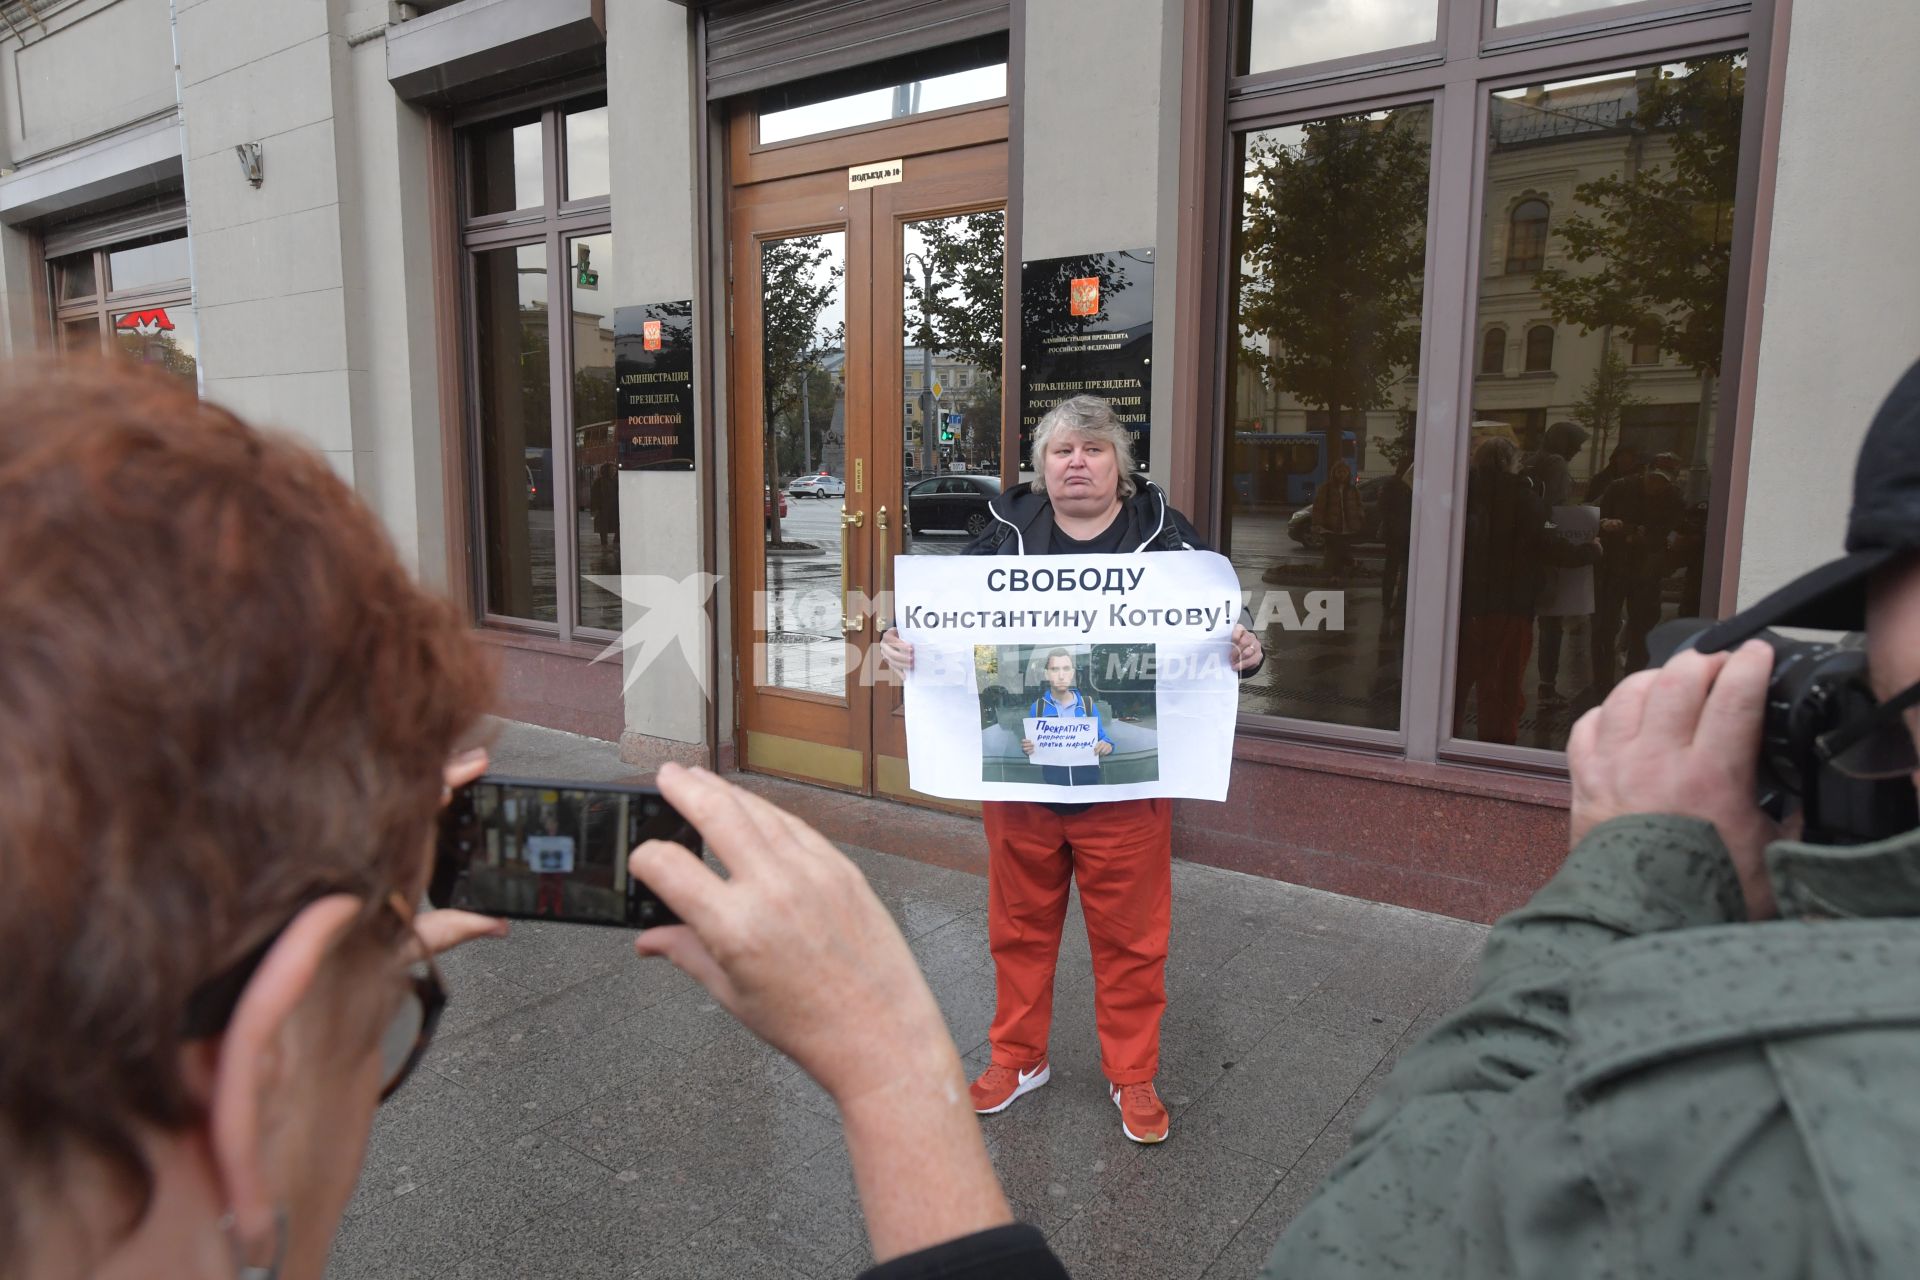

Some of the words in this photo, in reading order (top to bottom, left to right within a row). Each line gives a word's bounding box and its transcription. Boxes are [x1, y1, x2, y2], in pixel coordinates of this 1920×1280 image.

[852, 171, 883, 182] ПОДЪЕЗД
[1043, 335, 1090, 344] АДМИНИСТРАЦИЯ
[1092, 333, 1128, 341] ПРЕЗИДЕНТА
[1049, 345, 1086, 353] РОССИЙСКОЙ
[621, 372, 689, 384] АДМИНИСТРАЦИЯ
[1029, 382, 1083, 391] УПРАВЛЕНИЕ
[1085, 379, 1141, 389] ПРЕЗИДЕНТА
[630, 394, 679, 404] ПРЕЗИДЕНТА
[1029, 398, 1064, 408] РОССИЙ
[629, 413, 682, 424] РОССИЙСКОЙ
[632, 436, 679, 446] ФЕДЕРАЦИИ
[987, 567, 1145, 595] СВОБОДУ
[905, 604, 1098, 633] Константину
[1109, 600, 1231, 632] Котову!
